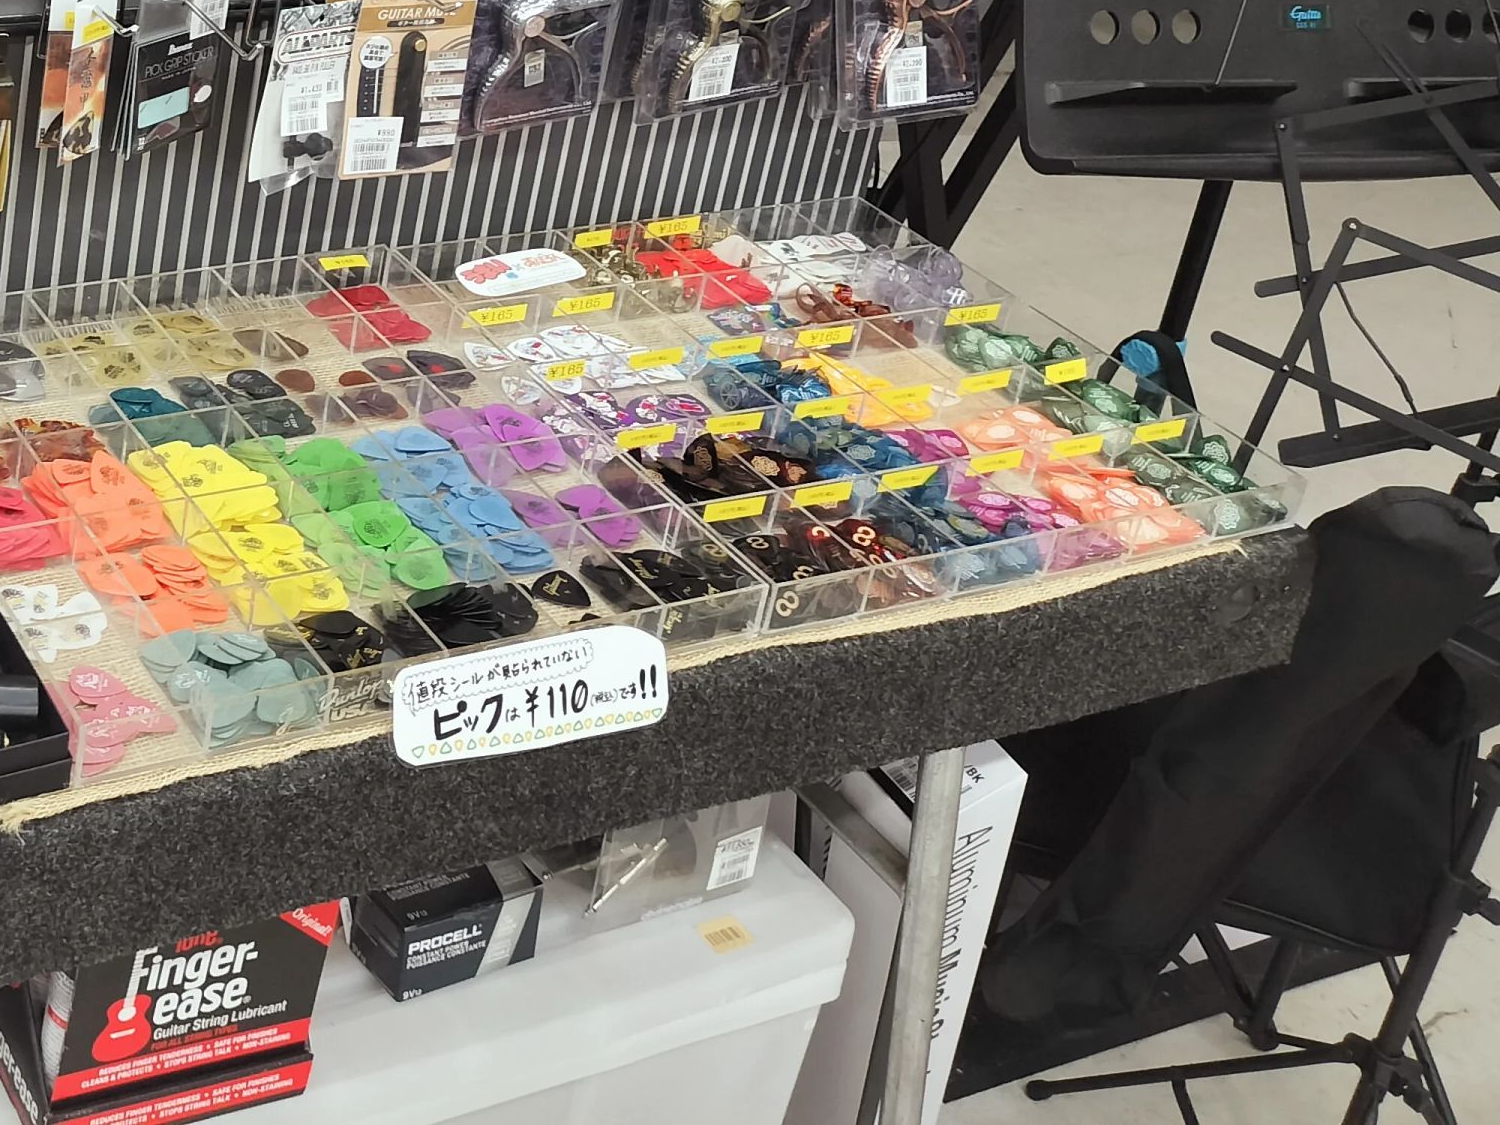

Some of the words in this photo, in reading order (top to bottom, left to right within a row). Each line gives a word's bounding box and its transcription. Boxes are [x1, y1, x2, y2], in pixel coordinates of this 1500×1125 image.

[377, 7, 422, 20] GUITAR
[408, 925, 482, 955] PROCELL
[152, 978, 243, 1025] ease
[153, 1022, 191, 1040] Guitar
[192, 1014, 229, 1031] String
[231, 1000, 287, 1022] Lubricant
